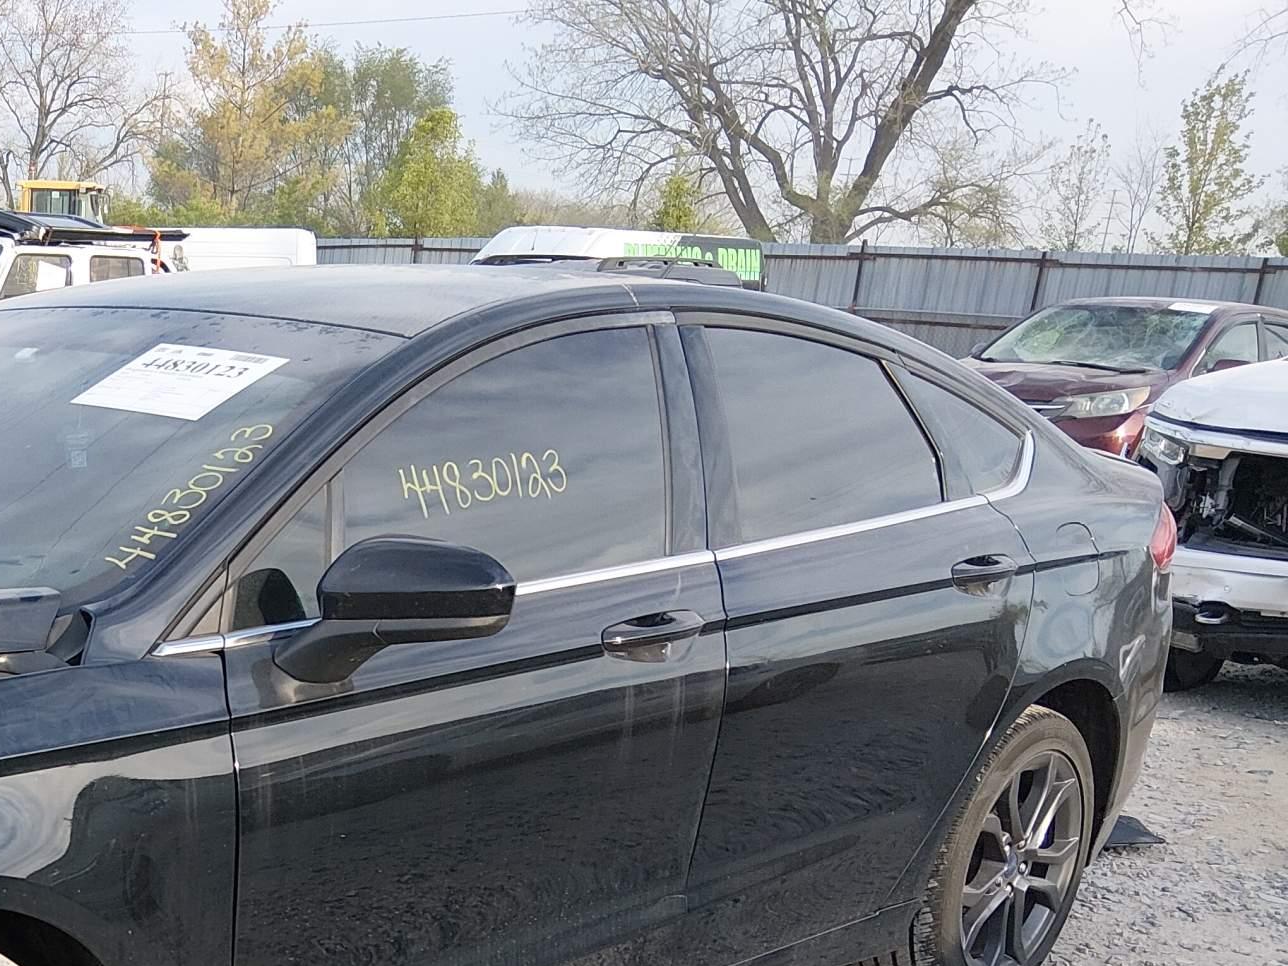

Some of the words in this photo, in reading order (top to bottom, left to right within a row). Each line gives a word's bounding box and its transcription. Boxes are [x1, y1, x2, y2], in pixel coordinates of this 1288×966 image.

[141, 357, 250, 379] 44830123
[104, 424, 273, 569] 44830123
[399, 449, 567, 519] 44830123
